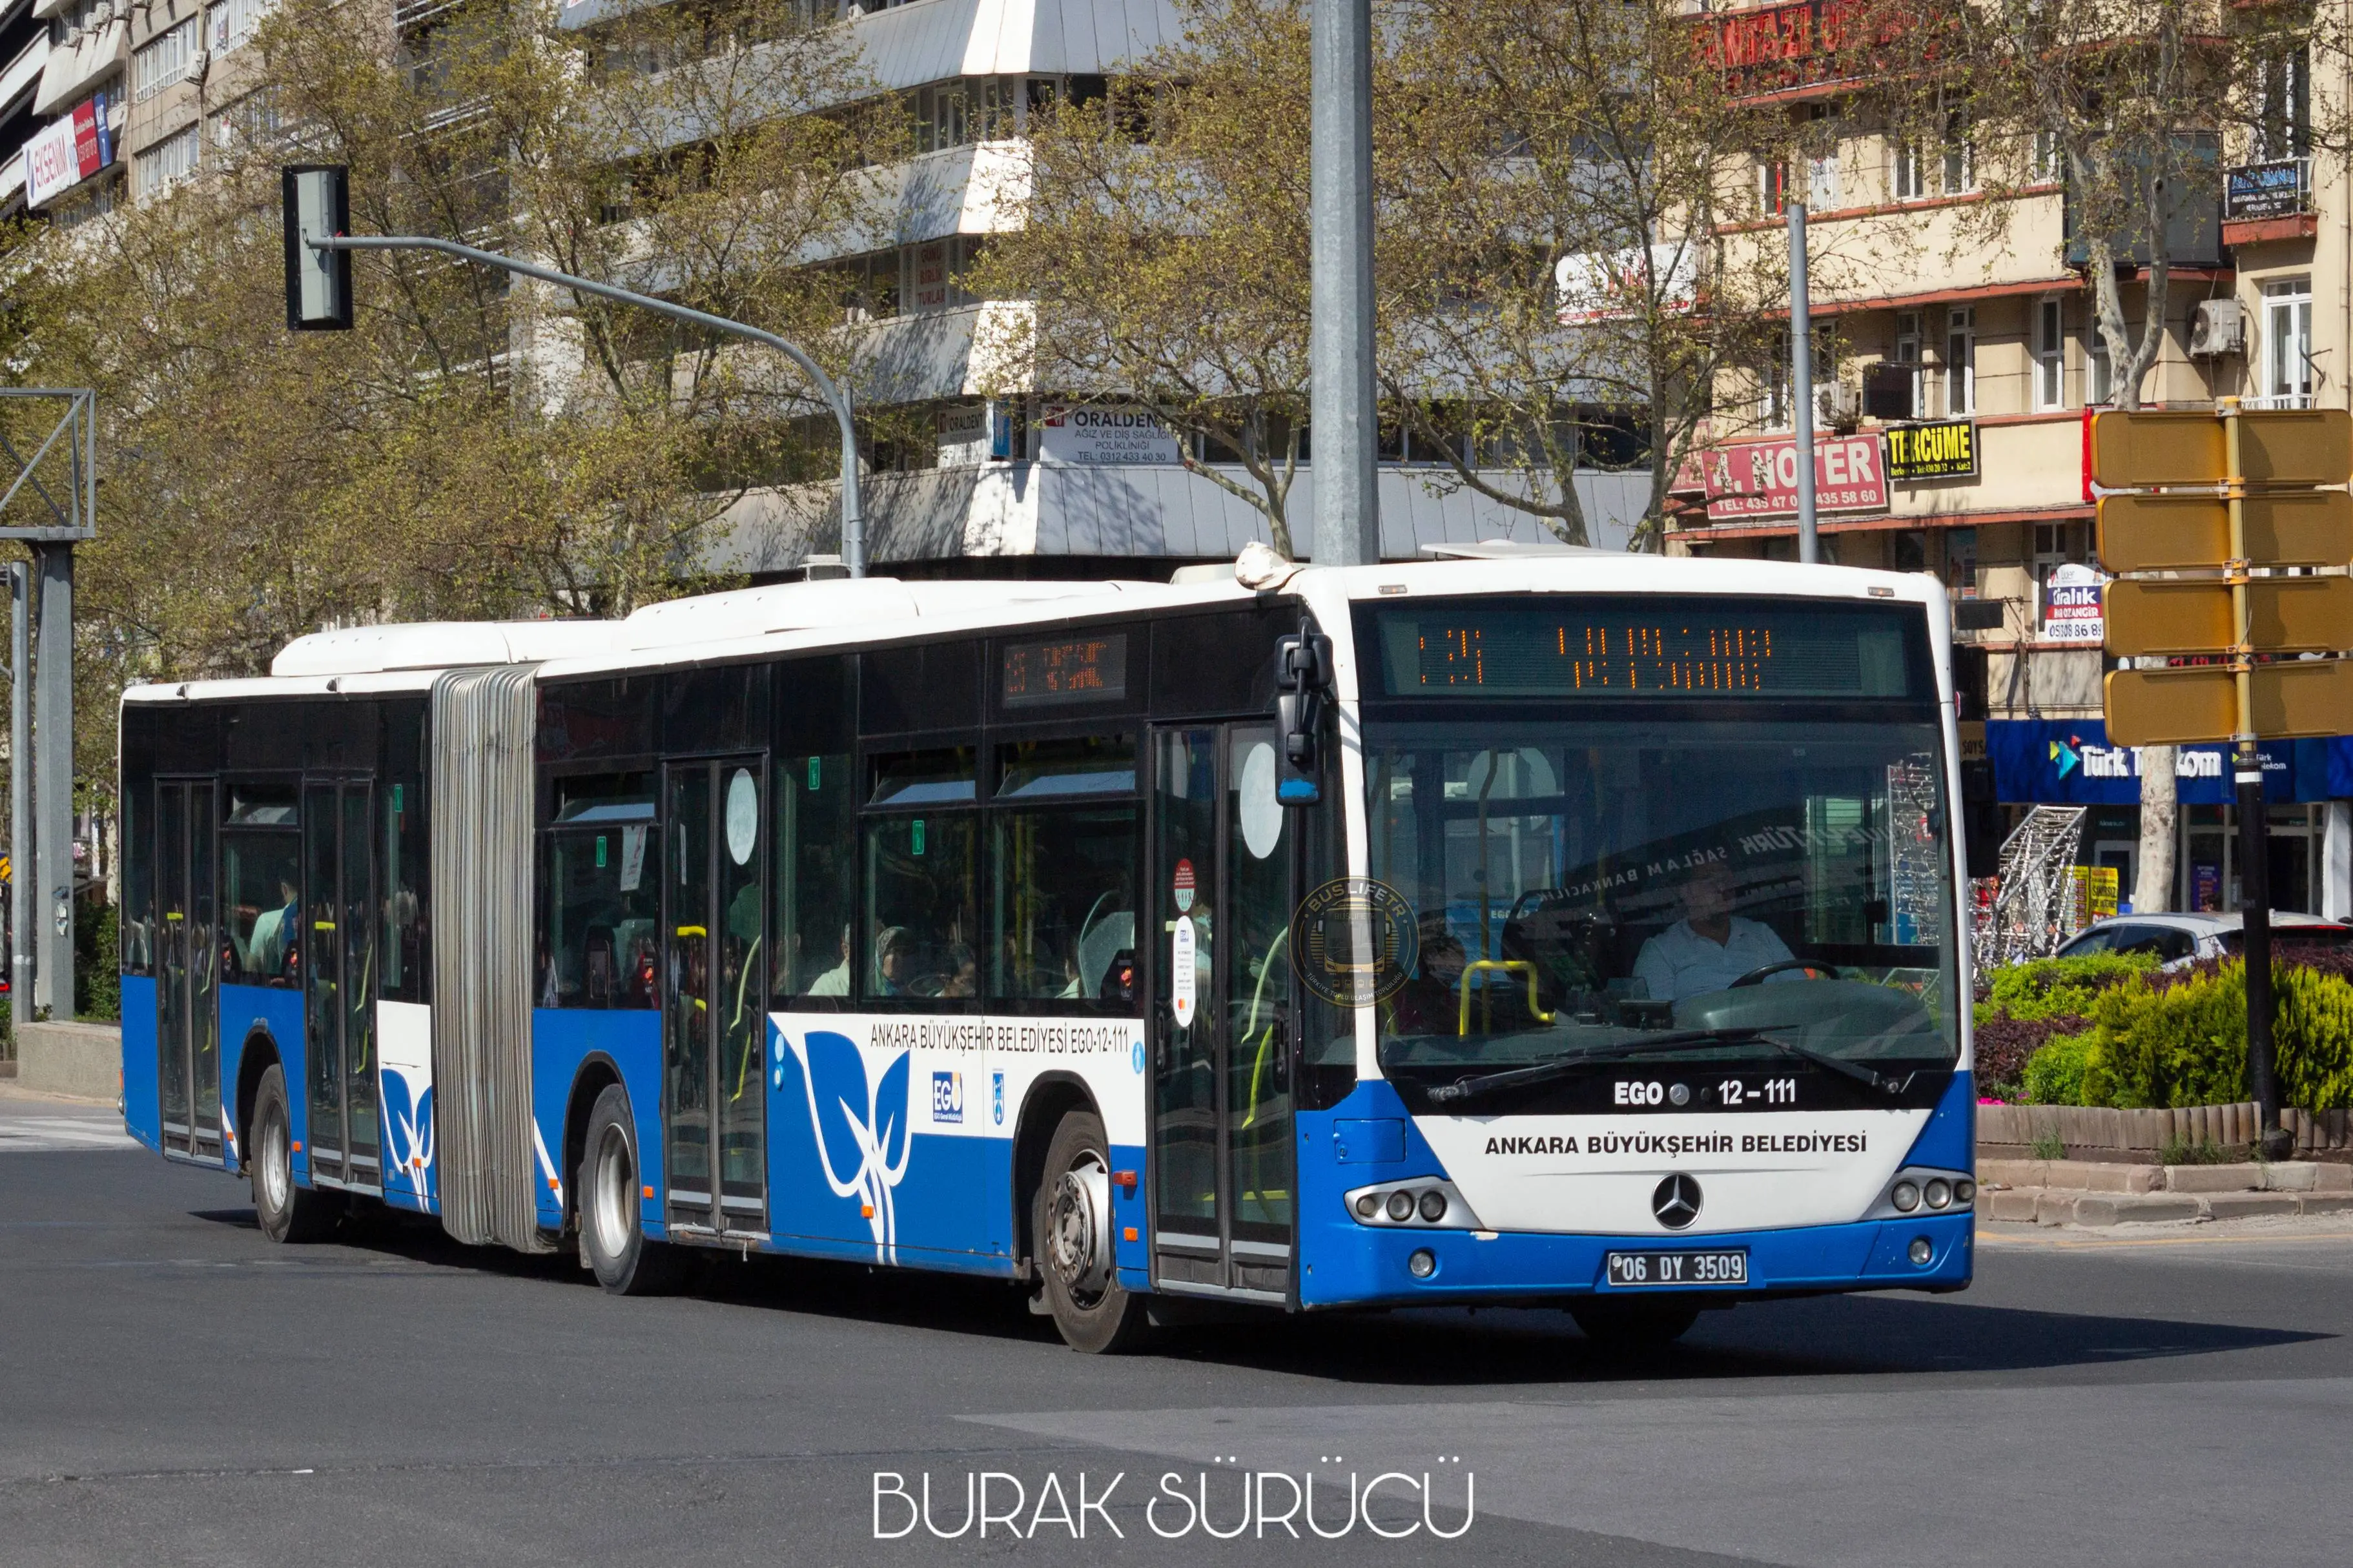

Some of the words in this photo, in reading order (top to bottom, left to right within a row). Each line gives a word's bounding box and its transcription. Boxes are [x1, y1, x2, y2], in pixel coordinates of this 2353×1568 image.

[950, 413, 983, 432] ORALDENT
[1074, 411, 1160, 428] ORALDEN
[1074, 429, 1098, 438] AĞIZ
[1100, 430, 1112, 438] VE
[1115, 429, 1130, 440] DİŞ
[1888, 425, 1971, 464] TERCÜME
[1078, 451, 1097, 460] TEL:
[1100, 451, 1121, 461] 0312
[1124, 451, 1140, 461] 433
[1142, 452, 1153, 462] 40
[1717, 498, 1743, 511] TEL:
[1746, 496, 1769, 509] 435
[1771, 495, 1785, 508] 47
[1816, 491, 1839, 505] 435
[1842, 491, 1858, 504] 58
[1861, 489, 1877, 502] 60
[2079, 746, 2129, 777] Türk
[2130, 746, 2221, 777] Tkom
[870, 1023, 917, 1049] ANKARA
[920, 1020, 994, 1057] BÜYÜKŞEHİR
[998, 1022, 1067, 1054] BELEDİYESİ
[1071, 1026, 1129, 1054] EGO-12-111
[934, 1079, 962, 1112] EGO
[1614, 1081, 1663, 1105] EGO
[1485, 1135, 1579, 1155] ANKARA
[1587, 1130, 1733, 1159] BÜYÜKŞEHİR
[1742, 1130, 1867, 1153] BELEDİYESİ
[1622, 1256, 1647, 1281] 06
[1659, 1256, 1683, 1280] DY
[1694, 1255, 1743, 1280] 3509
